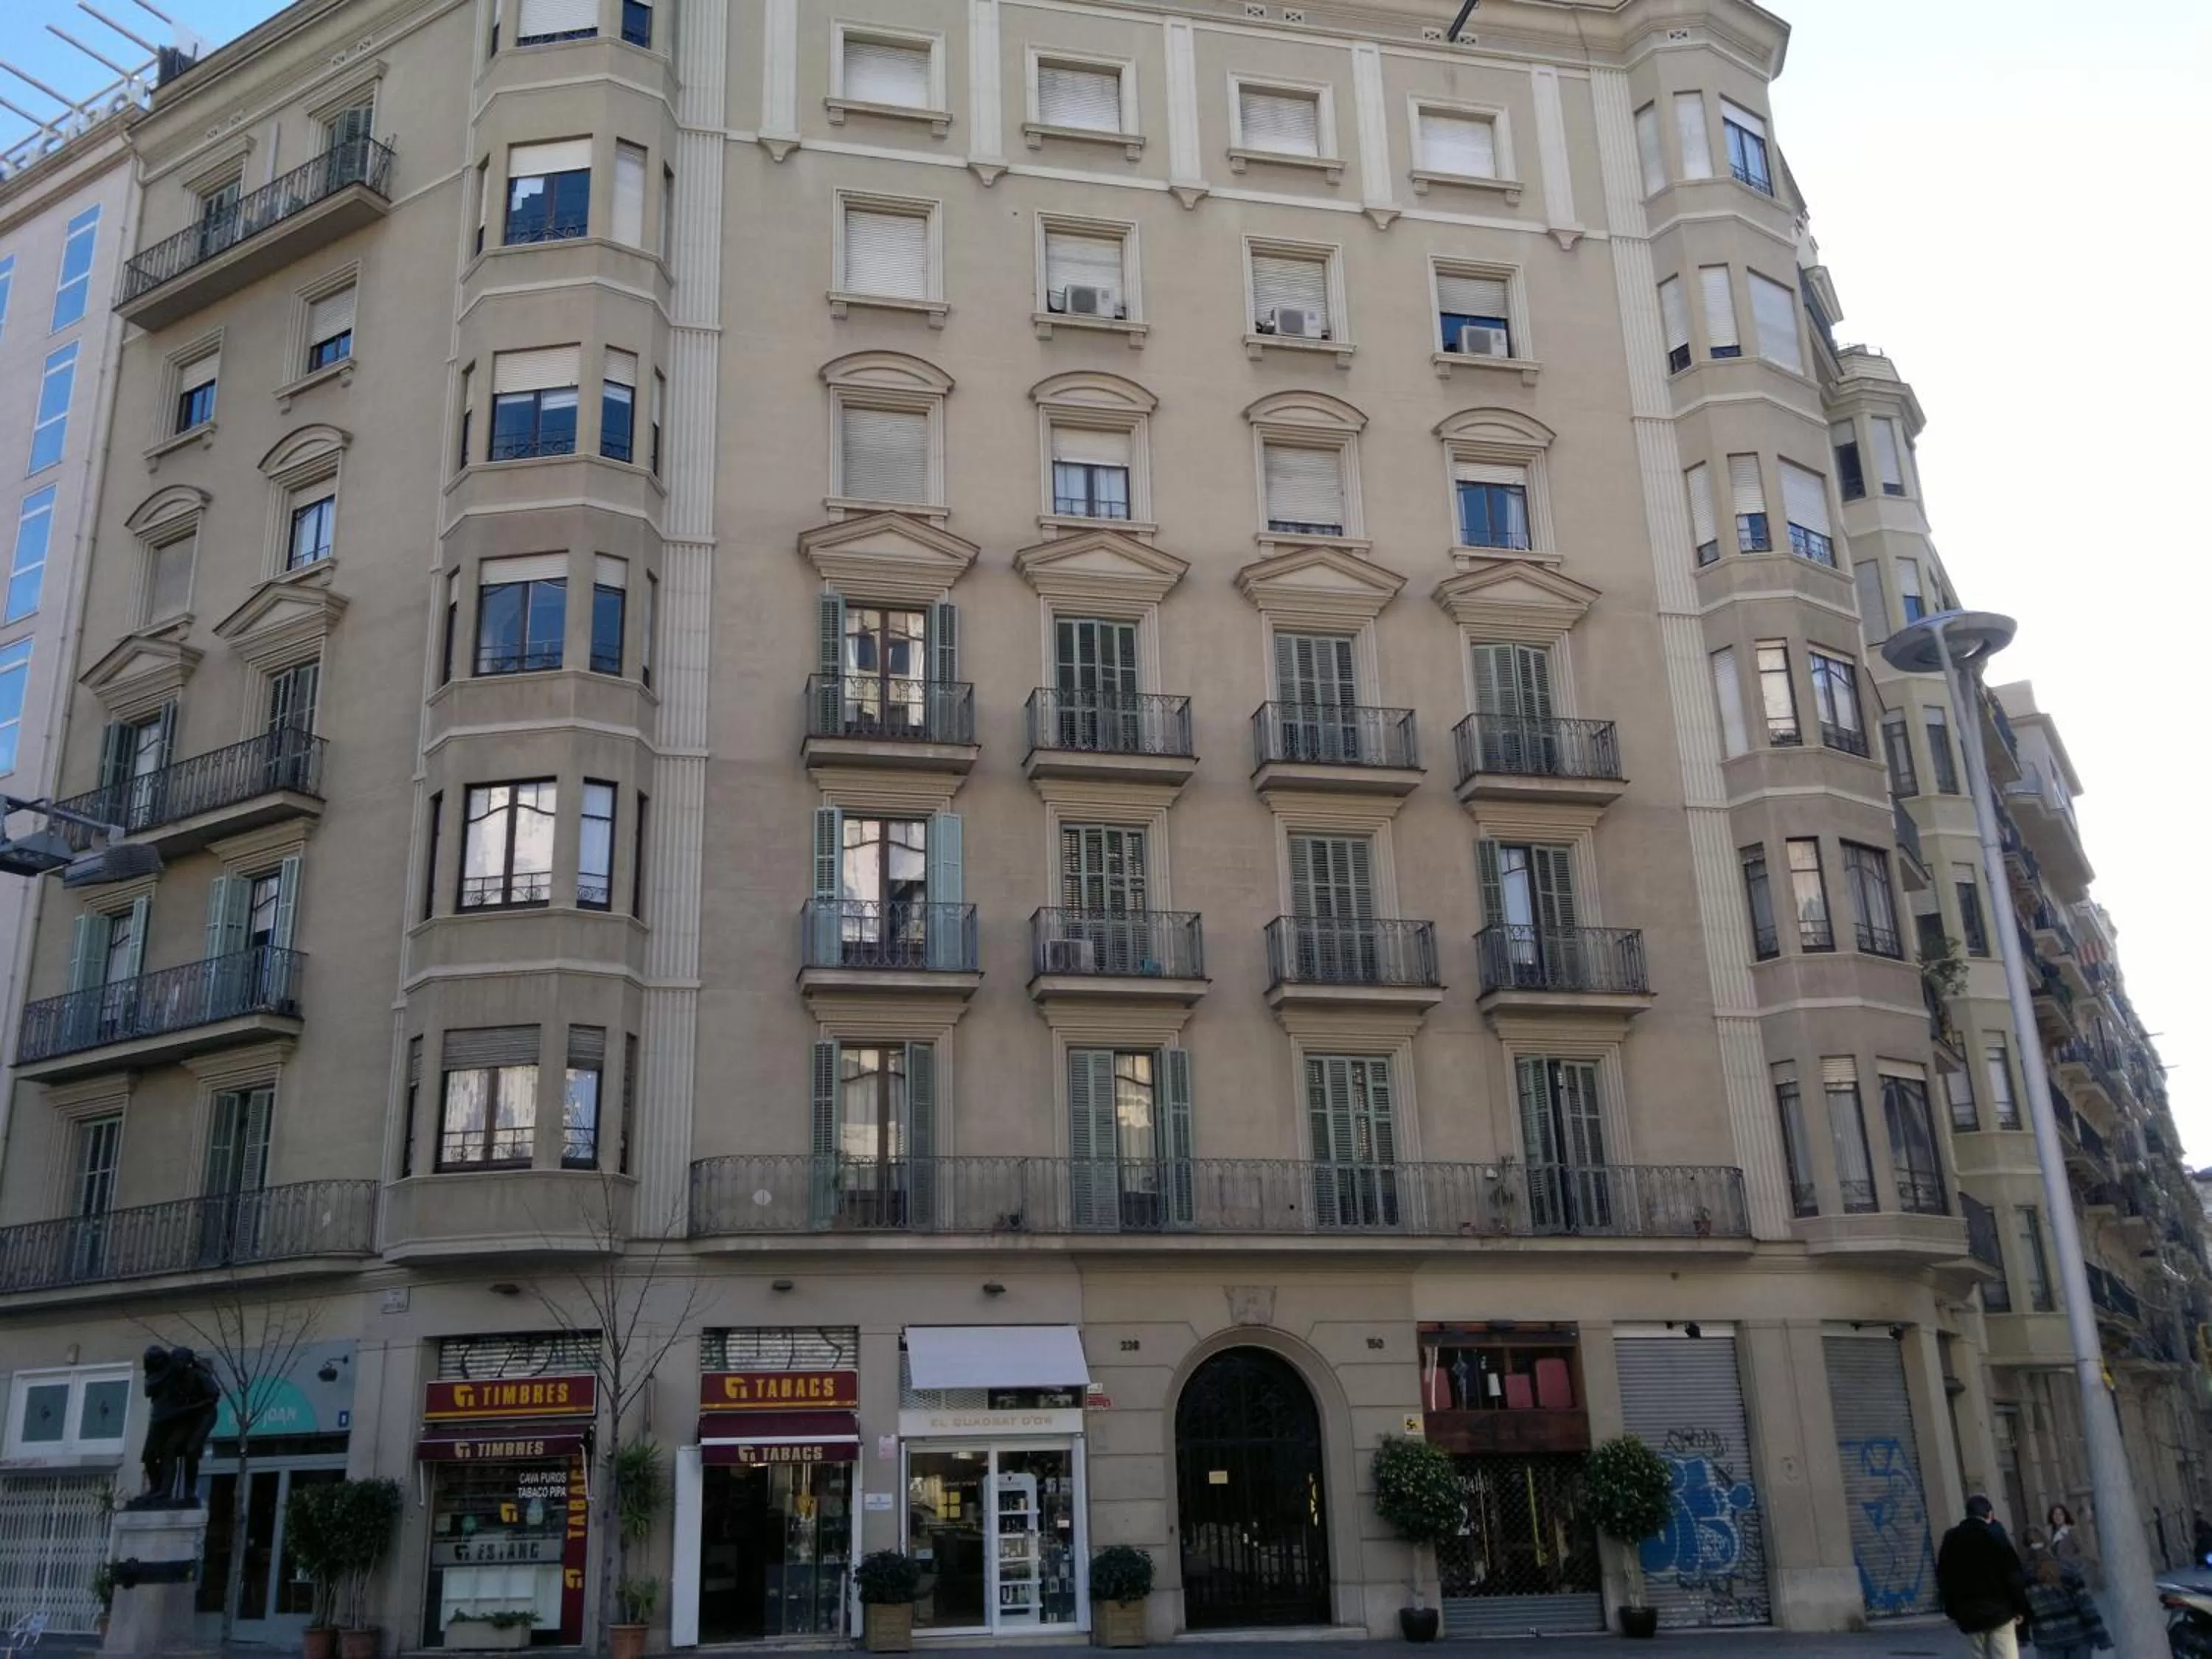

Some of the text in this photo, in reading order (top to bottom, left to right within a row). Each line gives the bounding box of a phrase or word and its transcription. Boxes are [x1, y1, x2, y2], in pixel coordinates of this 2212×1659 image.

[484, 1382, 569, 1406] TIMBRES
[757, 1377, 835, 1398] TABACS
[478, 1441, 544, 1457] TIMBRES
[762, 1445, 823, 1461] TABACS
[519, 1471, 567, 1484] CAVA PUROS
[518, 1486, 567, 1499] TABACO PIPA
